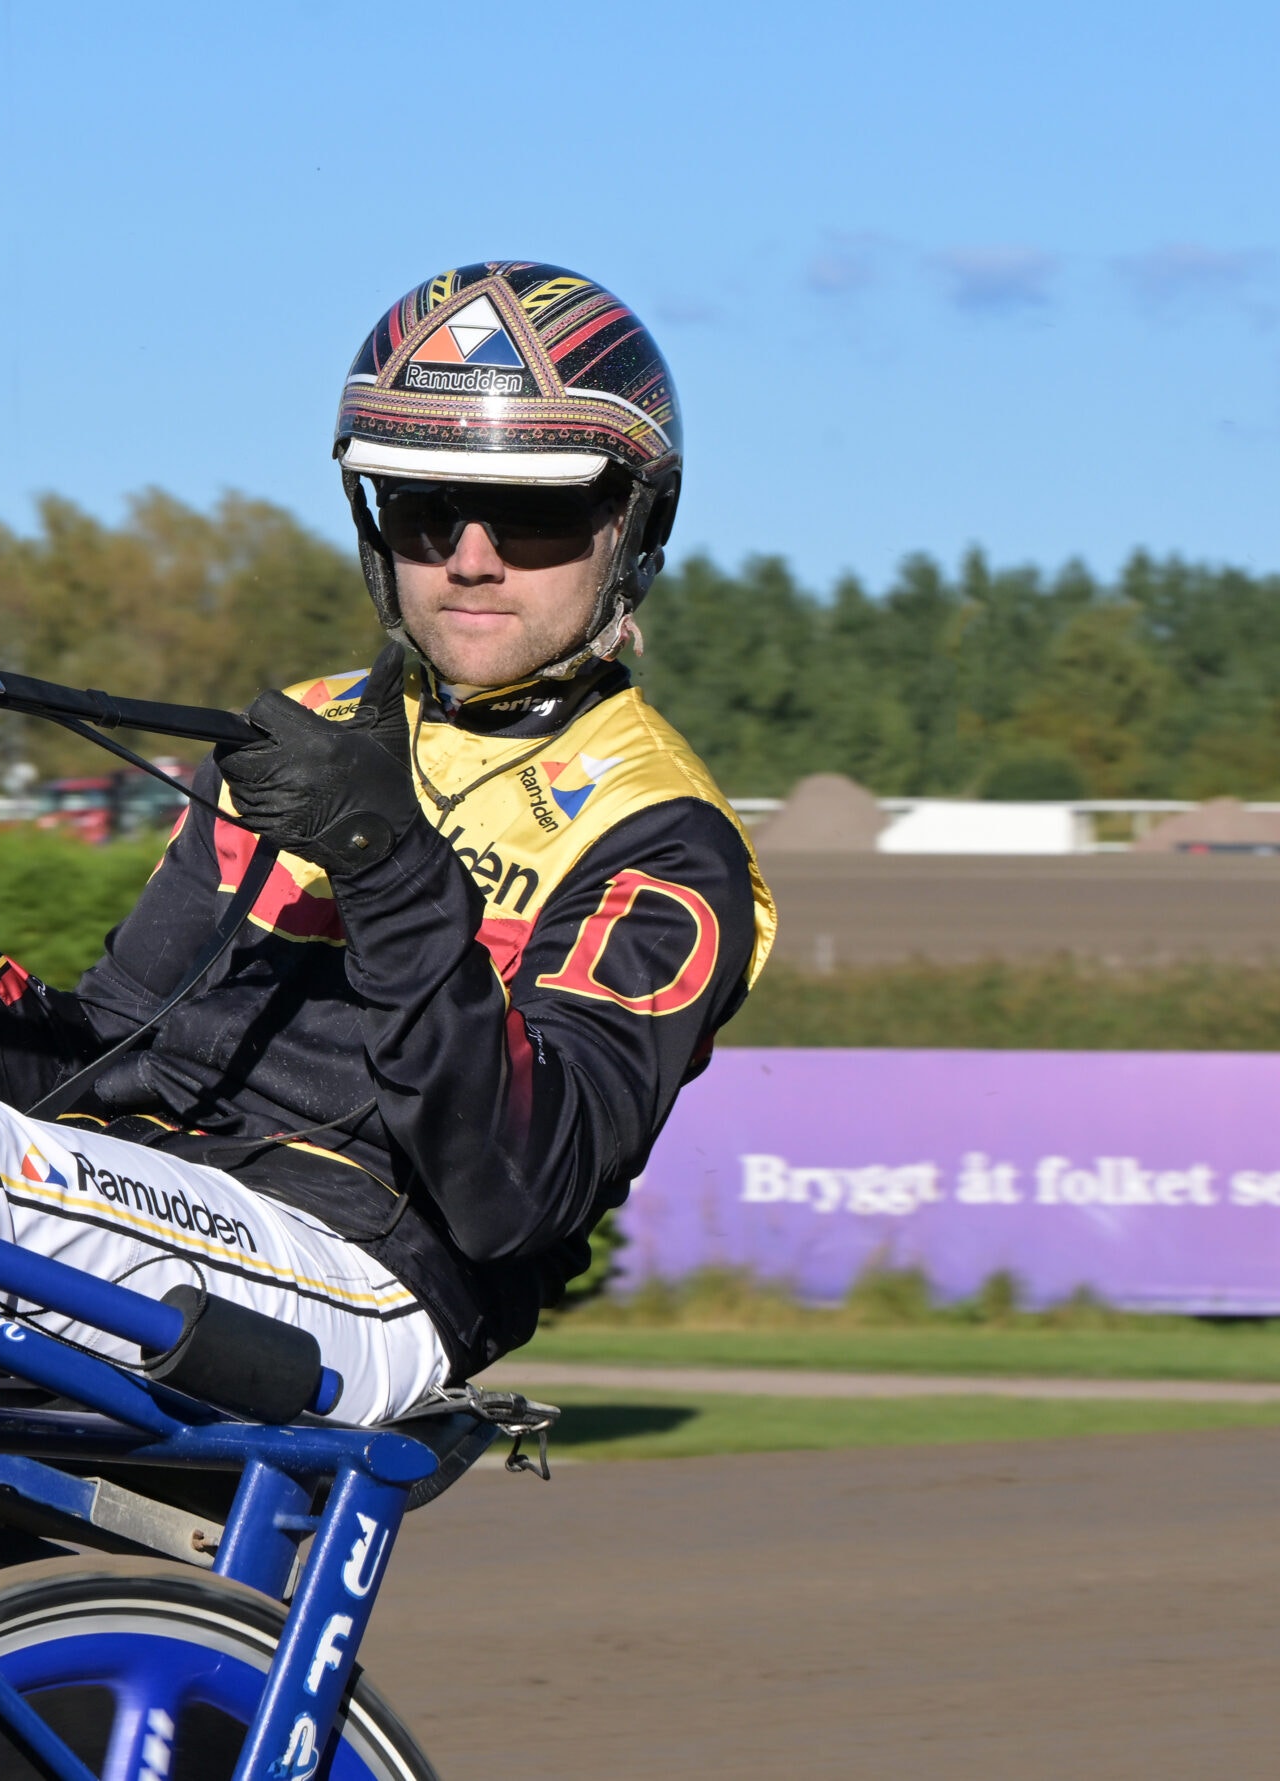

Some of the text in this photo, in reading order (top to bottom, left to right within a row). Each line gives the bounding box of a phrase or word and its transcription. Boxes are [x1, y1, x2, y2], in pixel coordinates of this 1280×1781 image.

[406, 365, 522, 392] Ramudden
[71, 1151, 258, 1254] Ramudden
[740, 1153, 939, 1214] Bryggt
[957, 1151, 1022, 1205] åt
[1035, 1155, 1217, 1207] folket
